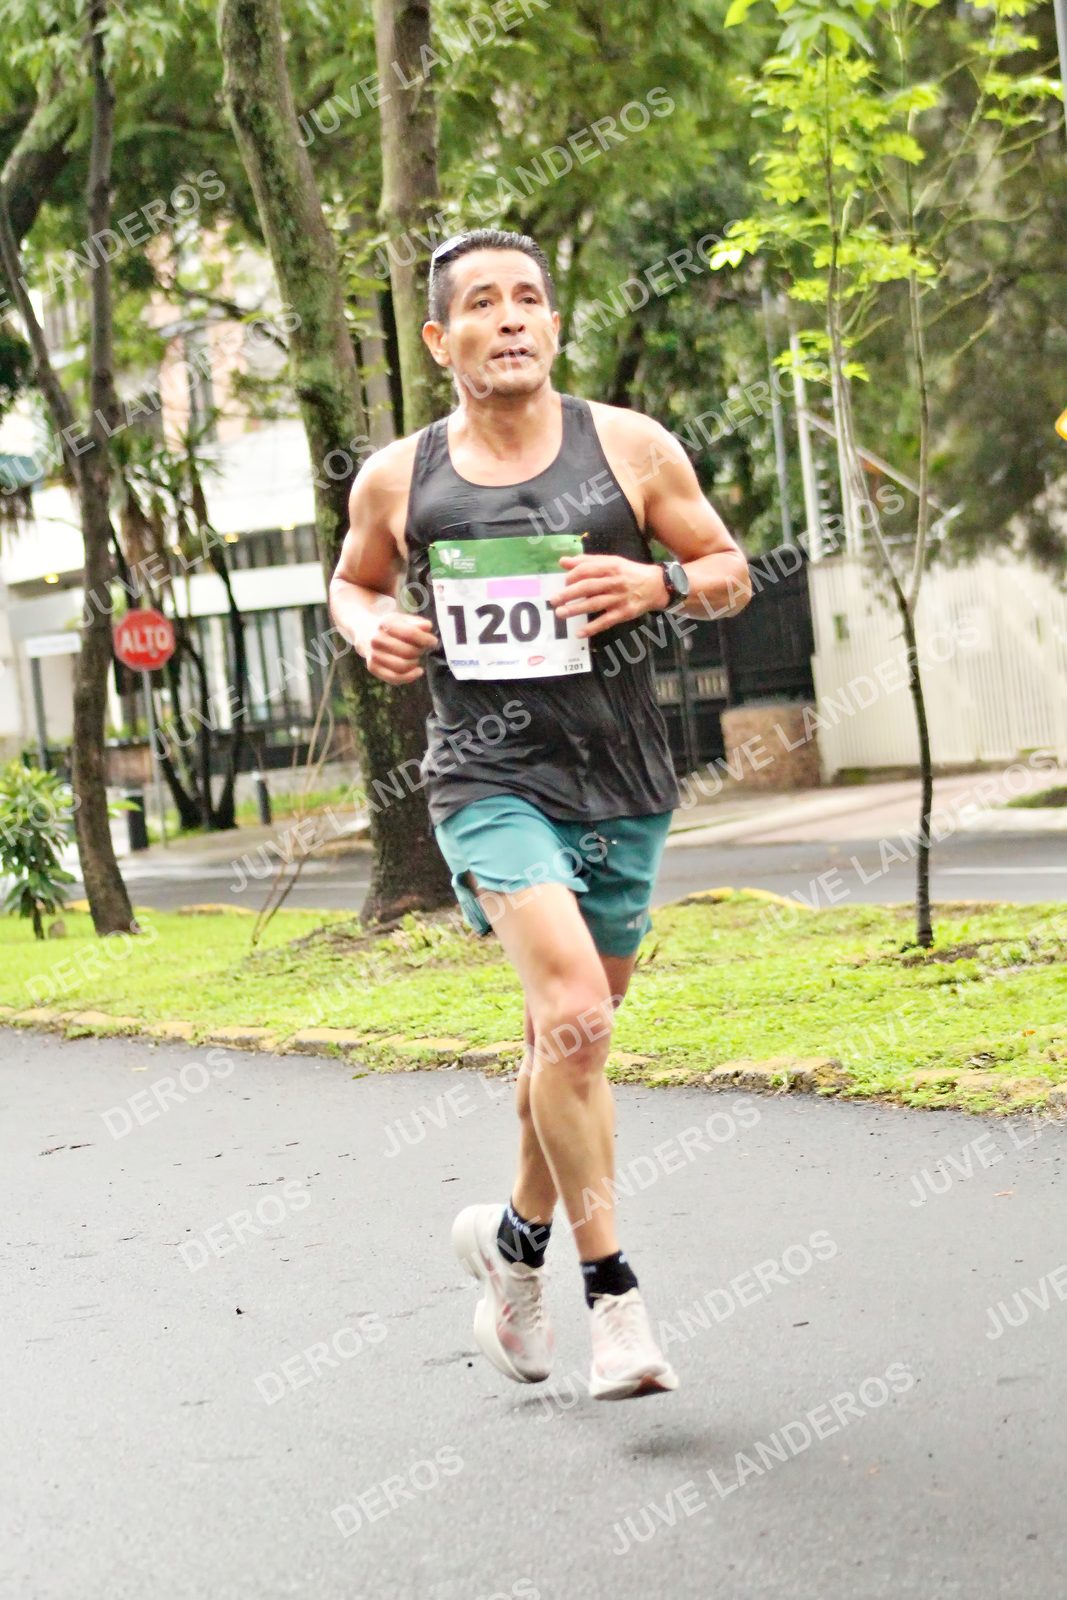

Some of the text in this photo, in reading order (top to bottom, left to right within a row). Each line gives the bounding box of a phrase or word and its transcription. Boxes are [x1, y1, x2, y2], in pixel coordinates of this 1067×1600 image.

[447, 601, 568, 645] 1201
[121, 626, 170, 654] ALTO
[564, 663, 584, 671] 1201
